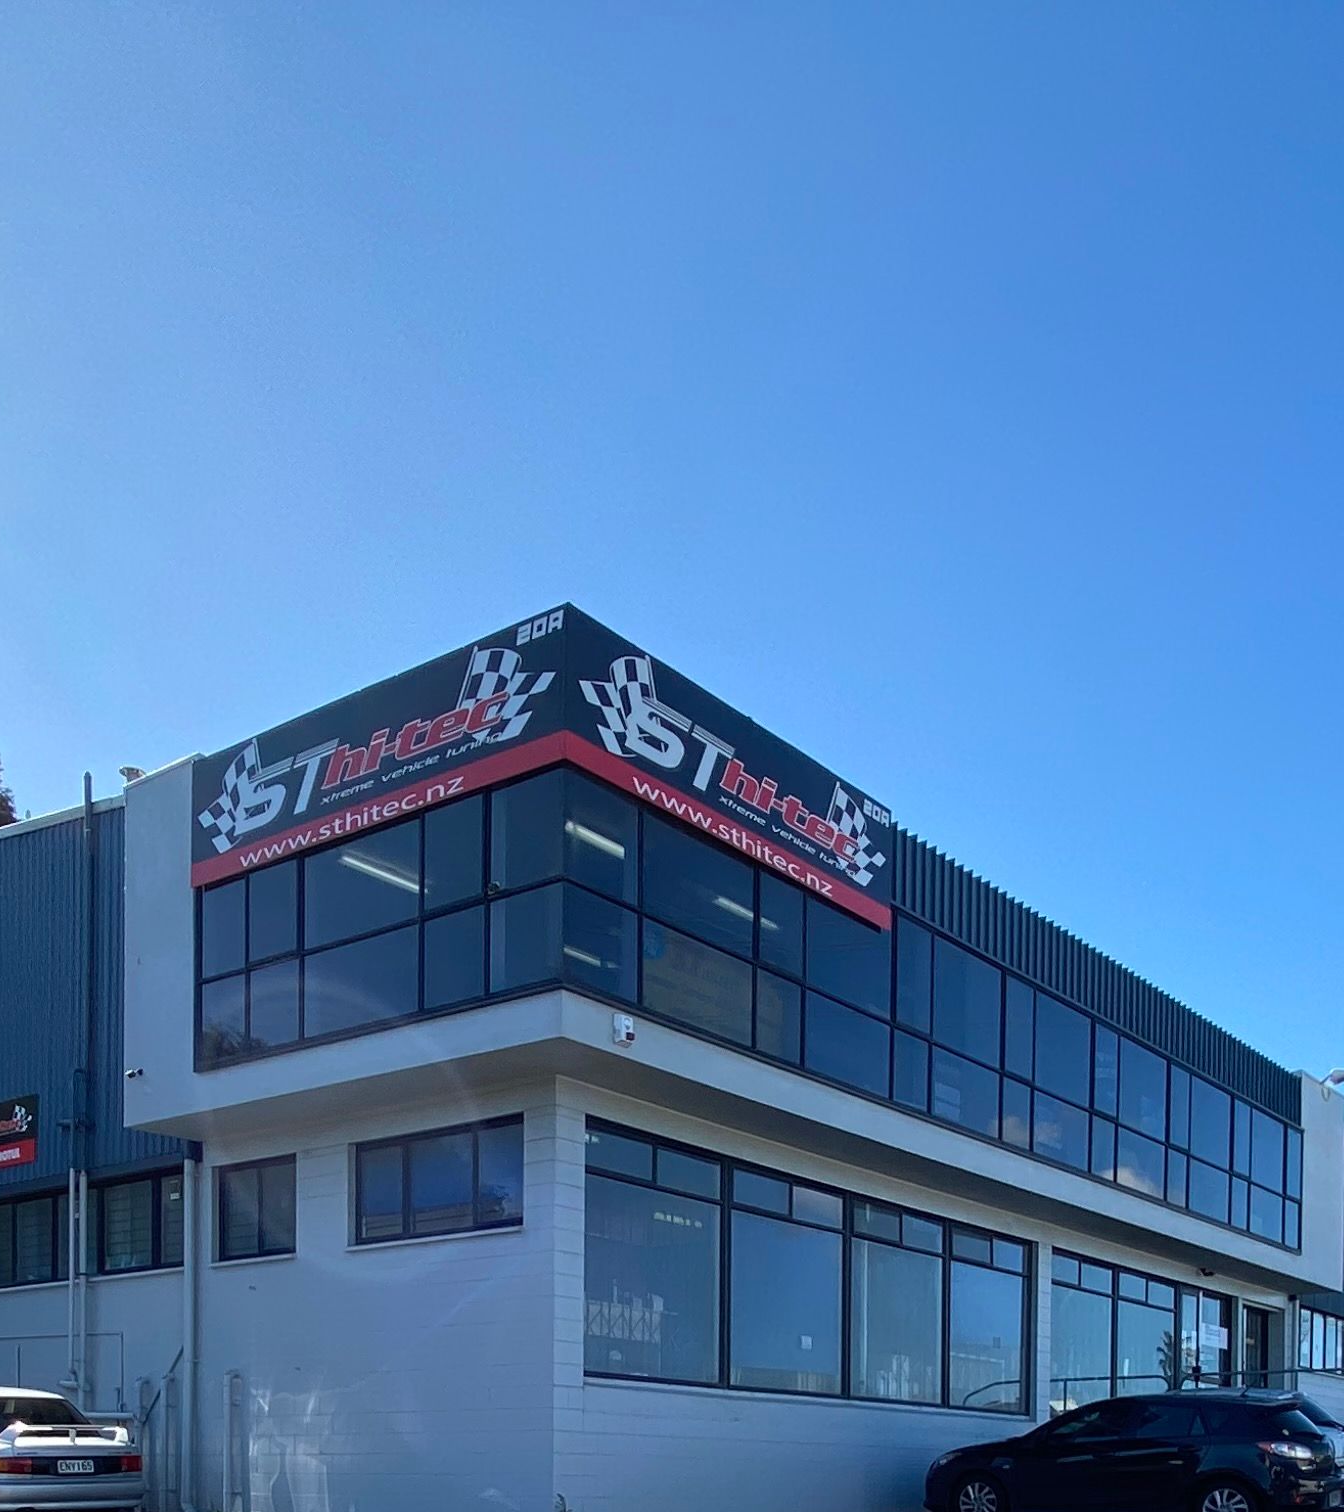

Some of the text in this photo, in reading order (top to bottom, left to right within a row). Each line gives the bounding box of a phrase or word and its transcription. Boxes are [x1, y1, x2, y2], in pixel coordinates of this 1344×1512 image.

[516, 609, 564, 646] 20A
[320, 730, 504, 805] xtreme vehicle tuning
[239, 774, 465, 868] www.sthitec.nz
[632, 776, 834, 898] www.sthitec.nz
[719, 795, 859, 880] xtreme vehicle tuning
[863, 797, 891, 828] 20A
